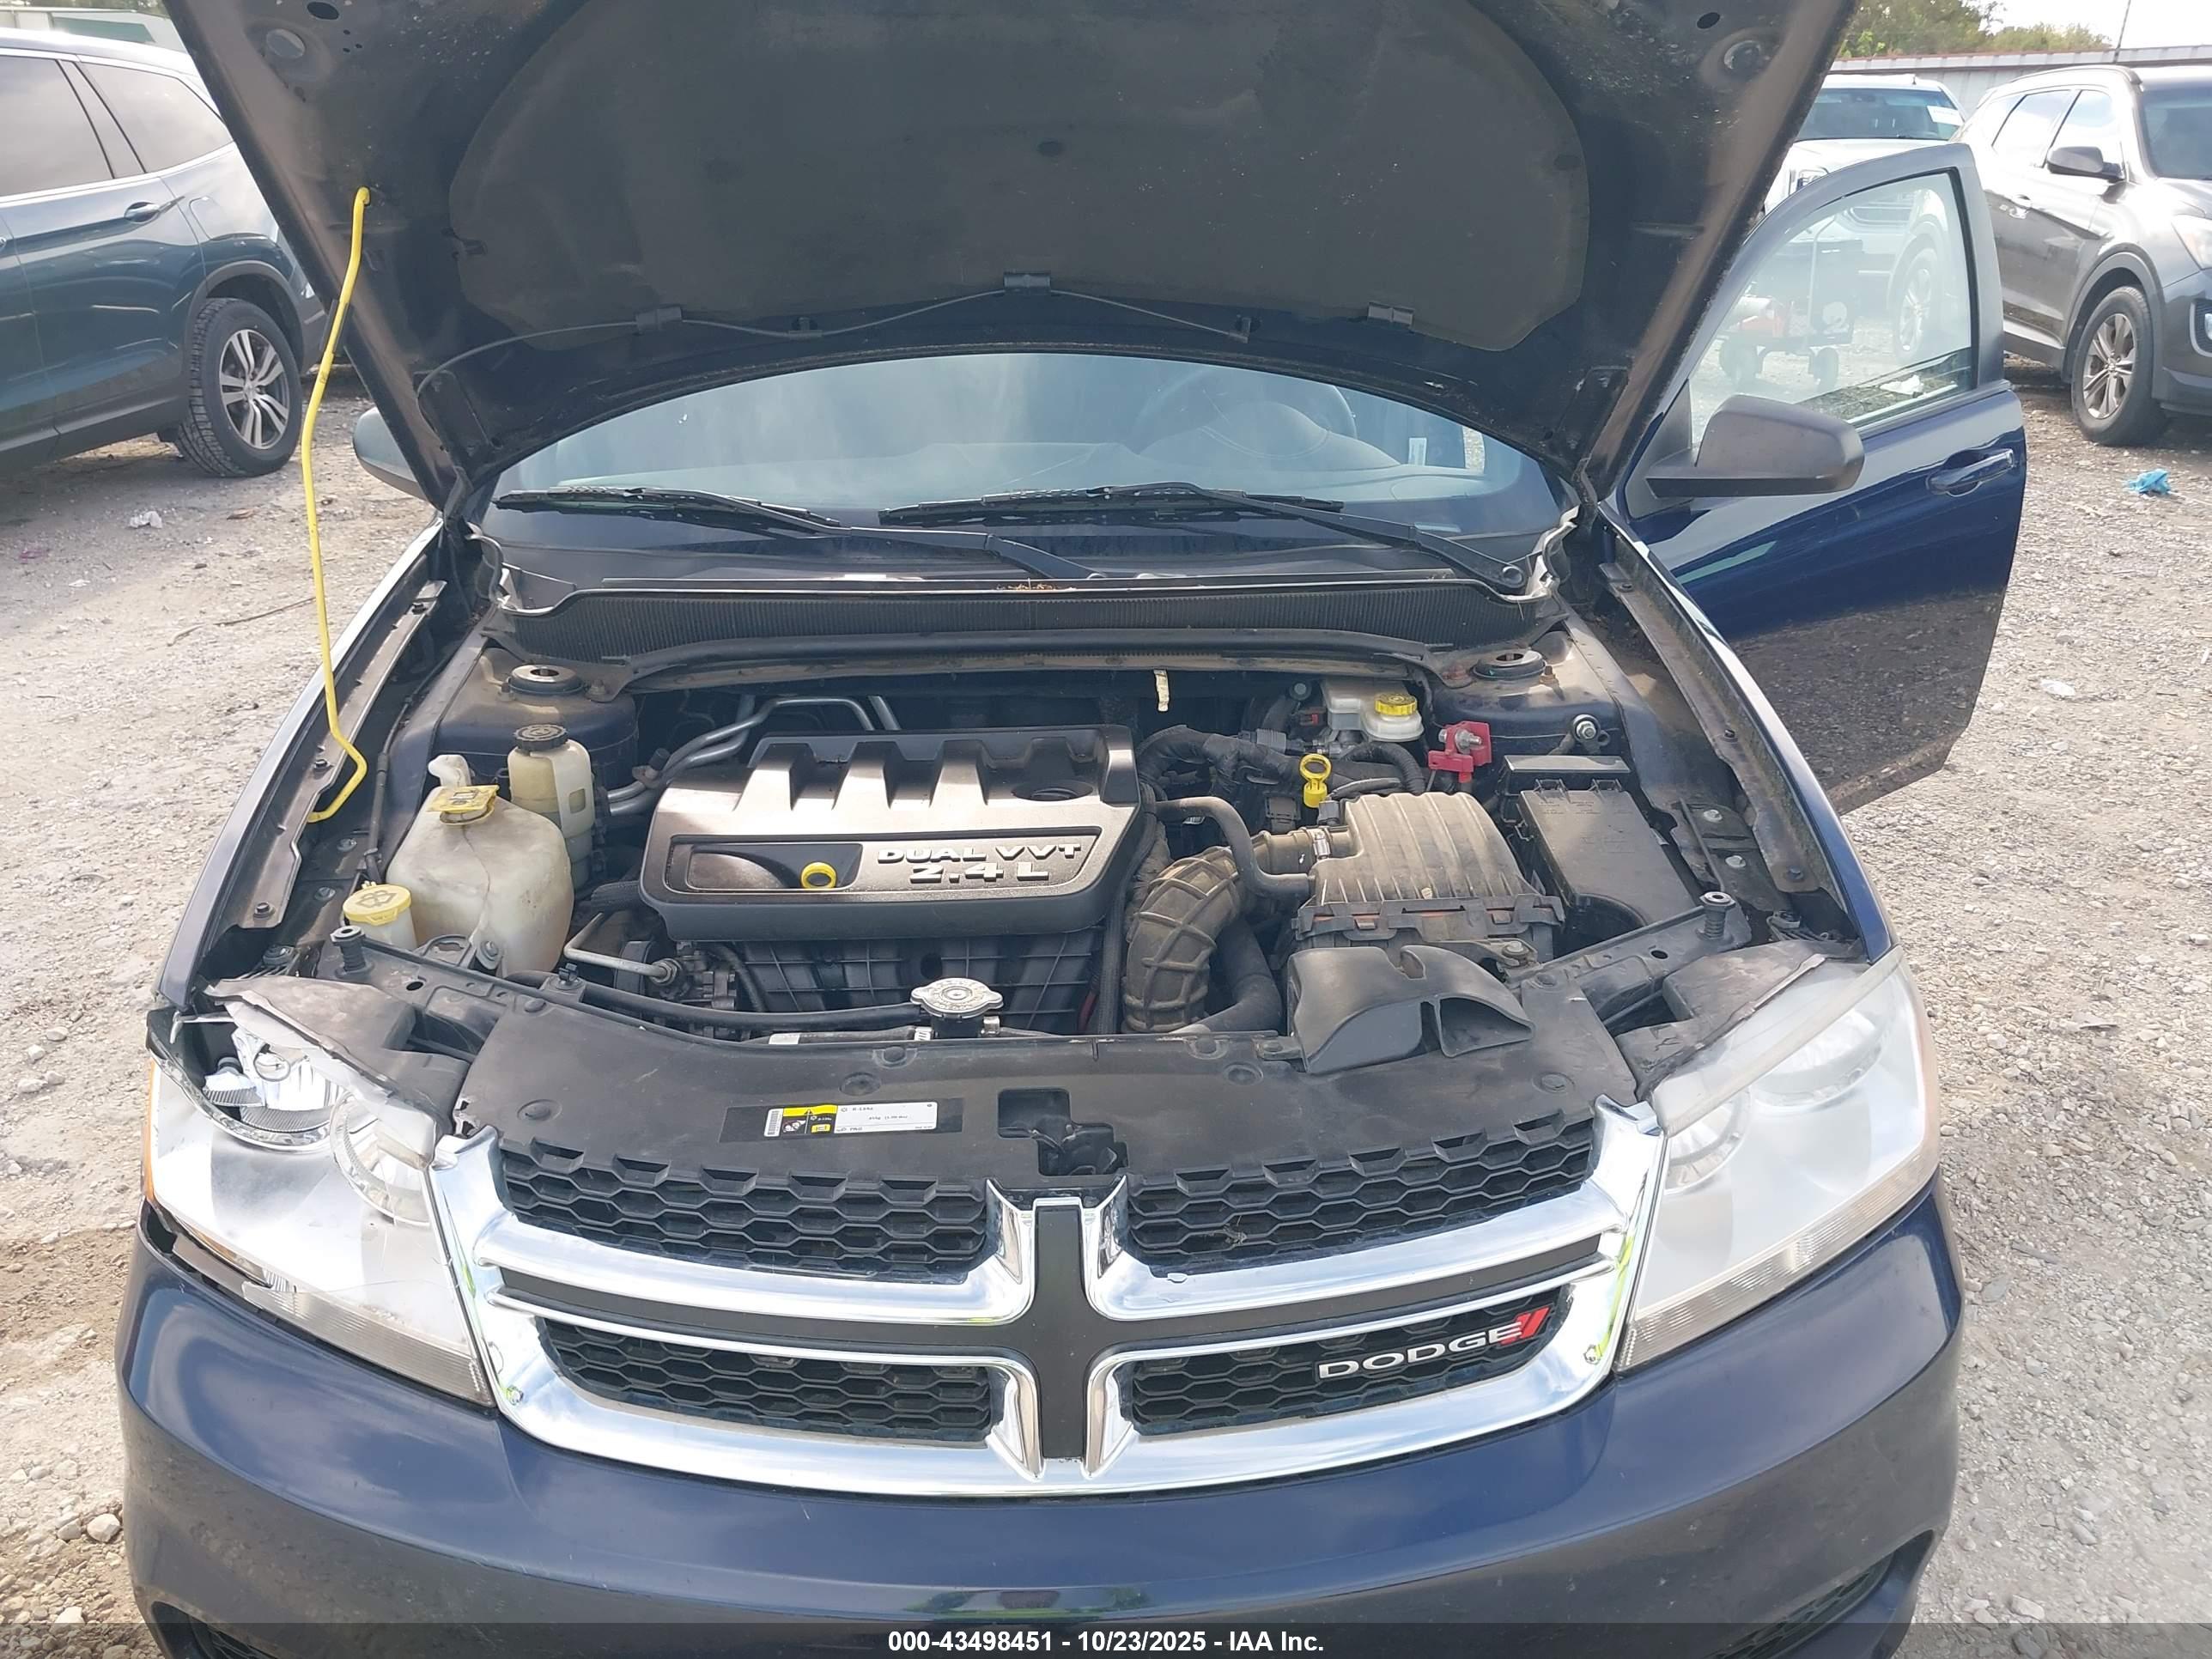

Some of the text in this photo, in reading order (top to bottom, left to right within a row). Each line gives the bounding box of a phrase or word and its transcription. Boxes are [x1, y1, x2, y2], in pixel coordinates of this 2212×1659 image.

[878, 844, 1082, 863] DUAL VVT
[910, 862, 1049, 884] 2.4 L
[1318, 1321, 1523, 1379] DODGE
